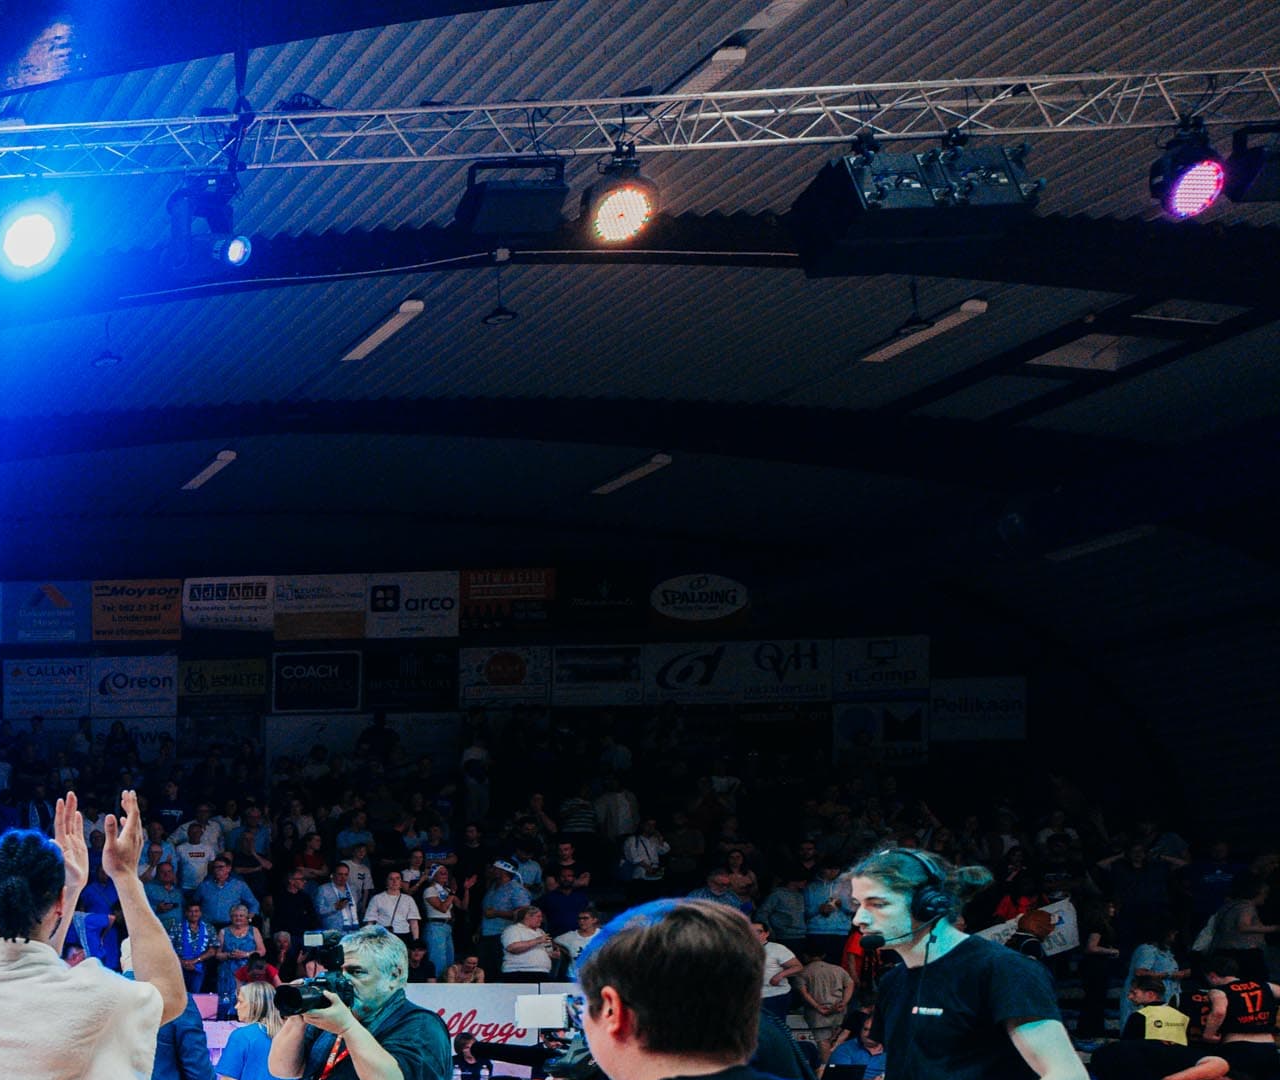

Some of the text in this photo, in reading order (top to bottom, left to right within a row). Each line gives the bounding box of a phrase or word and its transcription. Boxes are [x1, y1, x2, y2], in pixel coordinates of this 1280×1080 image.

[404, 597, 455, 612] arco
[26, 665, 84, 677] CALLANT
[280, 664, 339, 679] COACH
[109, 672, 173, 690] Oreon
[1240, 990, 1263, 1014] 17
